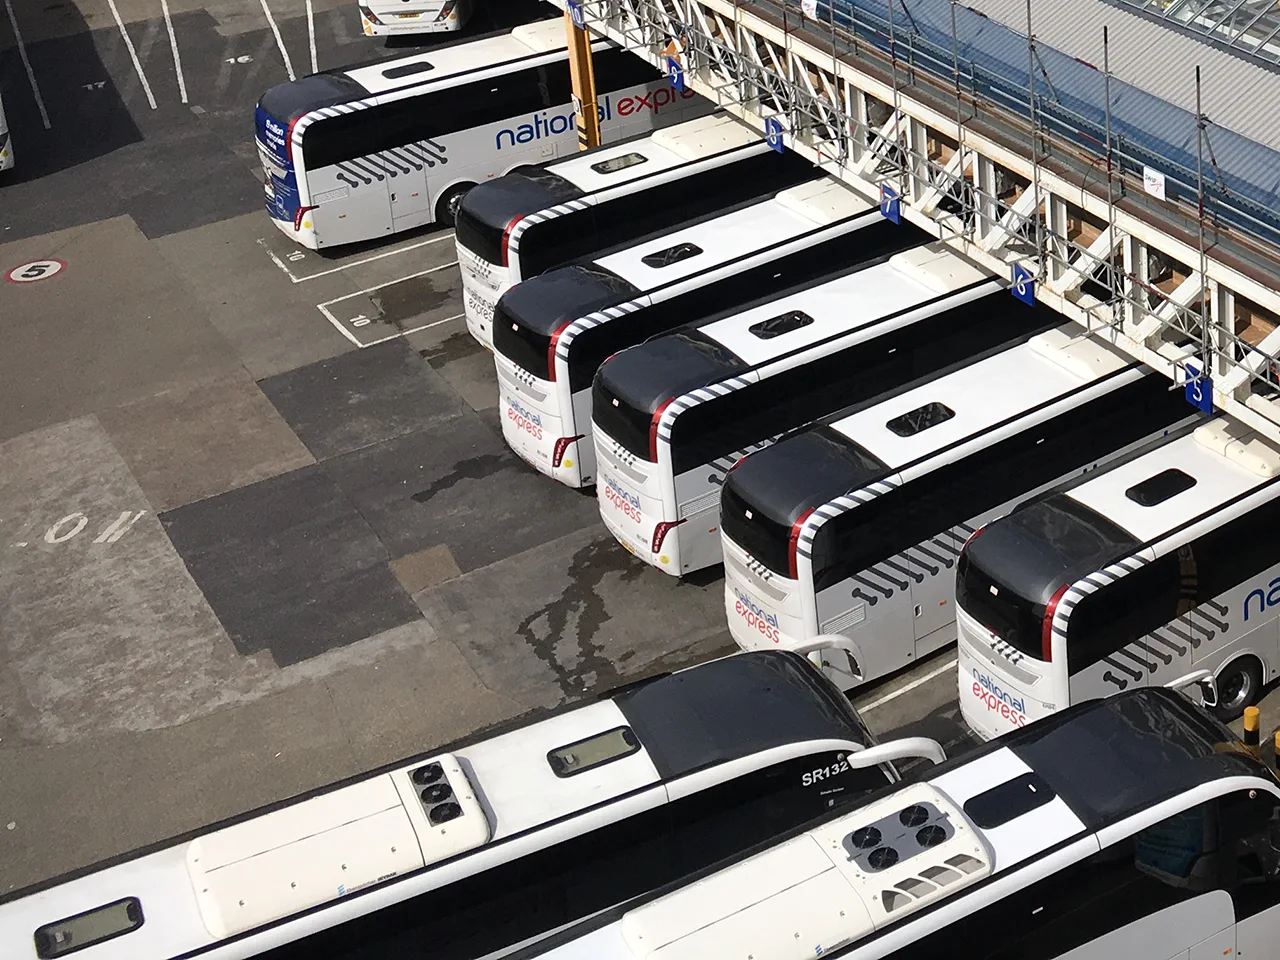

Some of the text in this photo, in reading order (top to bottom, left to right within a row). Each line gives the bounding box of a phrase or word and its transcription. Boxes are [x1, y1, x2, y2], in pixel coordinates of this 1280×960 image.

[671, 65, 678, 84] 9
[770, 125, 777, 145] 8
[884, 192, 892, 213] 7
[21, 264, 51, 278] 5
[1017, 274, 1026, 295] 6
[349, 314, 371, 327] 10
[468, 298, 494, 322] expres
[1193, 379, 1203, 402] 5
[506, 396, 543, 428] national
[507, 407, 543, 441] express
[604, 473, 642, 511] national
[604, 485, 643, 524] express
[734, 587, 780, 630] national
[735, 600, 780, 644] express
[972, 667, 1026, 715] national
[972, 681, 1027, 728] express
[802, 760, 849, 787] SR132
